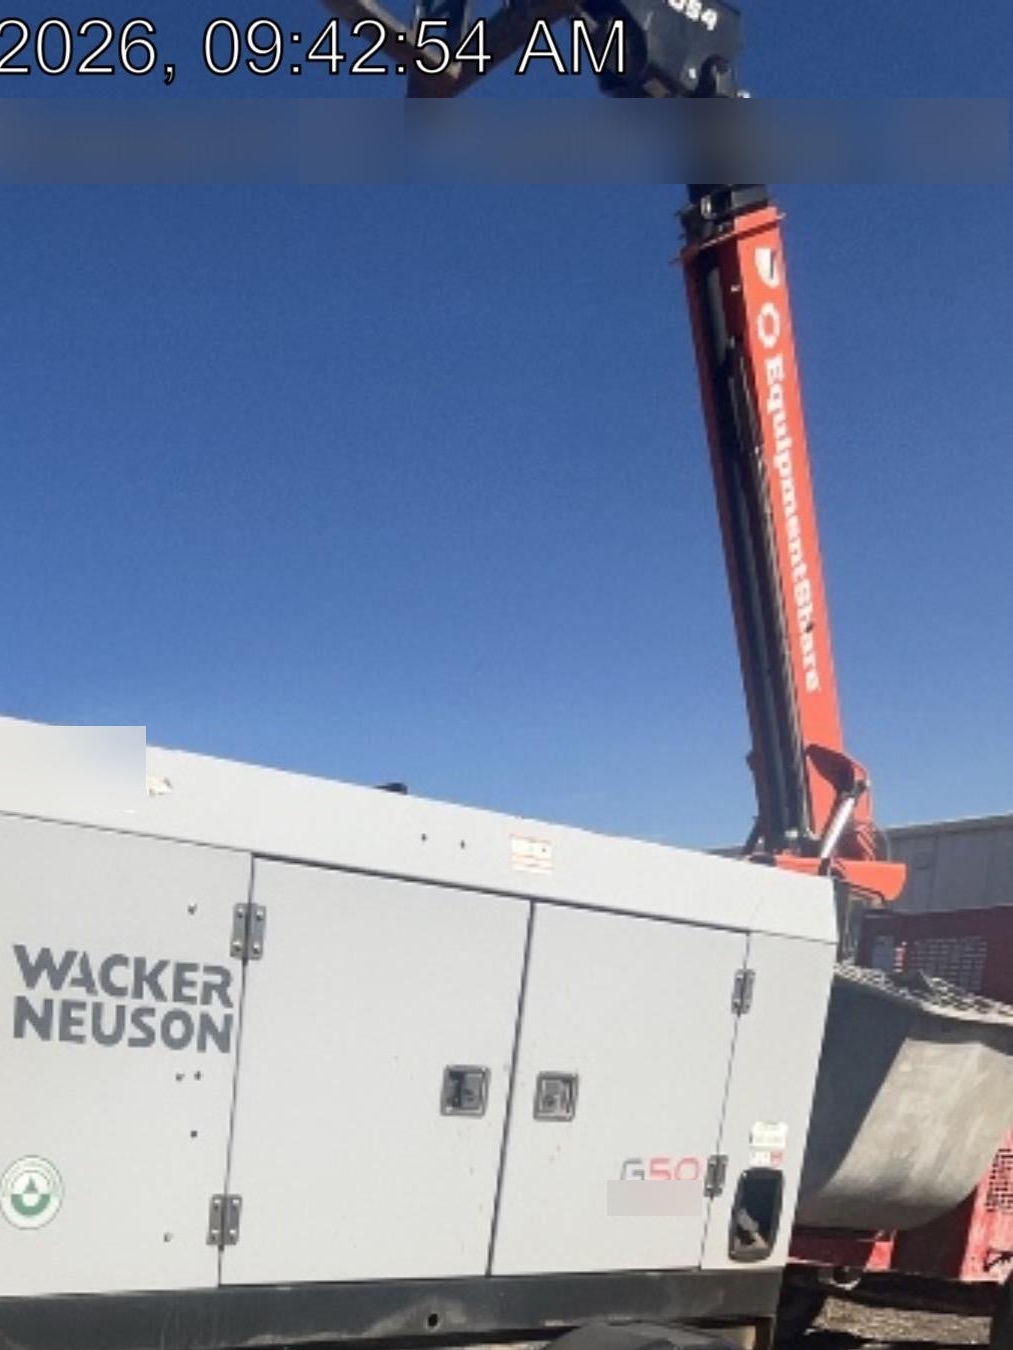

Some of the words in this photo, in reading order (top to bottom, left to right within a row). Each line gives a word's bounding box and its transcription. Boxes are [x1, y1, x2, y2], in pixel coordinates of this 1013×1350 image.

[764, 353, 820, 693] EquipmentShare
[13, 944, 234, 1009] WACKER
[13, 995, 234, 1055] NEUSON
